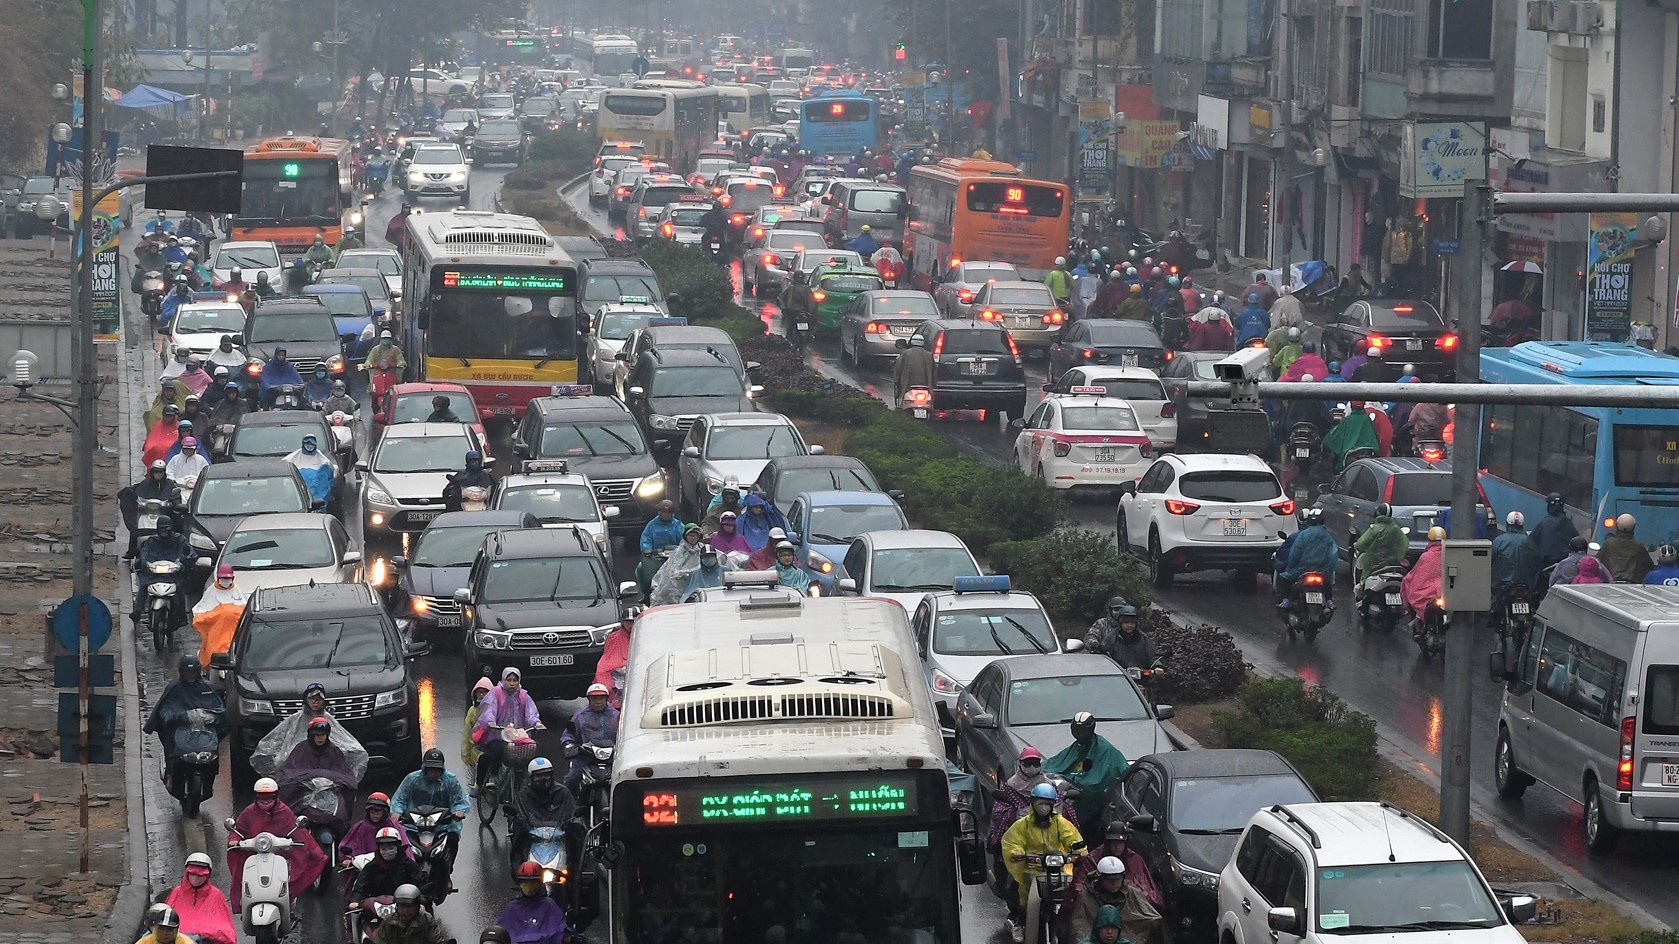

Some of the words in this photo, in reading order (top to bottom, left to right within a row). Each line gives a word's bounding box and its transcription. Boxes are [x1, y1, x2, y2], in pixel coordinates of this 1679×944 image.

[1437, 141, 1478, 157] Moon
[1083, 159, 1107, 168] TRANG
[1008, 188, 1022, 200] 90
[1611, 262, 1631, 273] CHỢ
[92, 279, 116, 291] RANG
[1594, 273, 1629, 290] THỜI
[1594, 289, 1629, 301] TRANG
[1100, 447, 1110, 455] 30A
[1228, 520, 1241, 528] 30E
[531, 655, 573, 666] 30E-601.60
